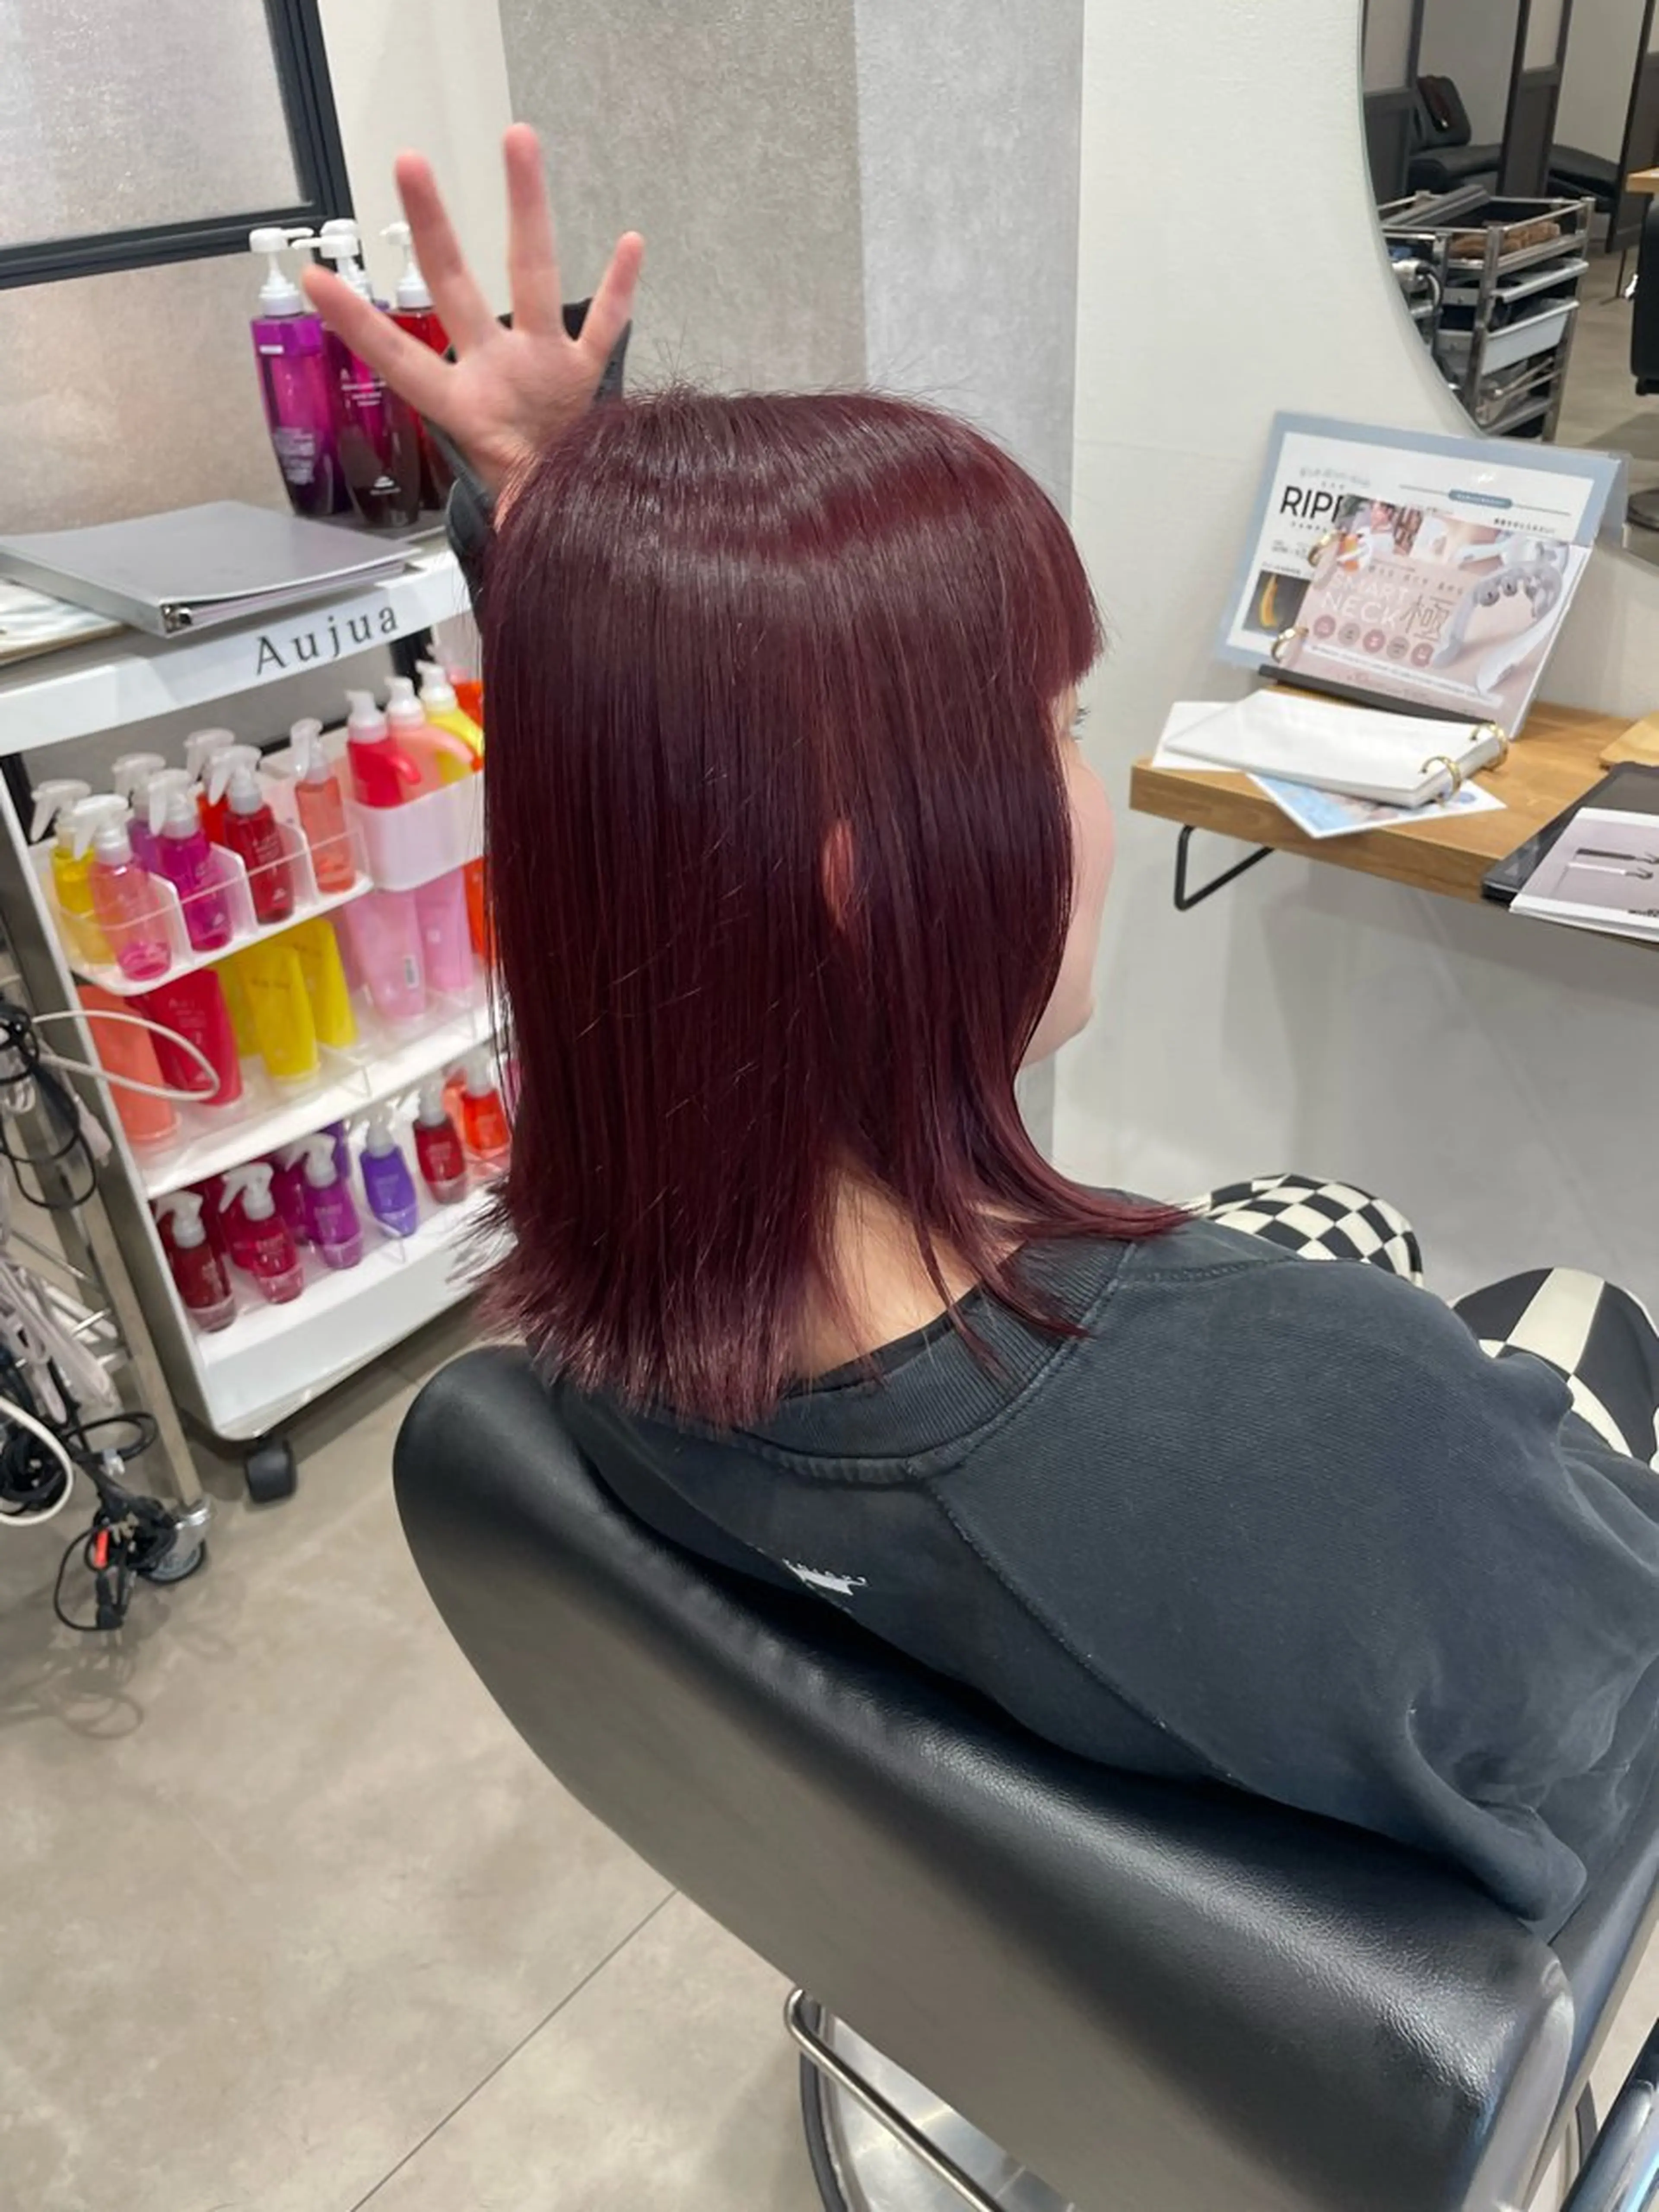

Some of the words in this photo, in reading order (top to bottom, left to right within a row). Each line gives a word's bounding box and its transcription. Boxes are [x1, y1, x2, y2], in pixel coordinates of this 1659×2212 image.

[1328, 569, 1409, 604] SMART
[1320, 591, 1402, 630] NECK
[256, 606, 399, 675] Aujua
